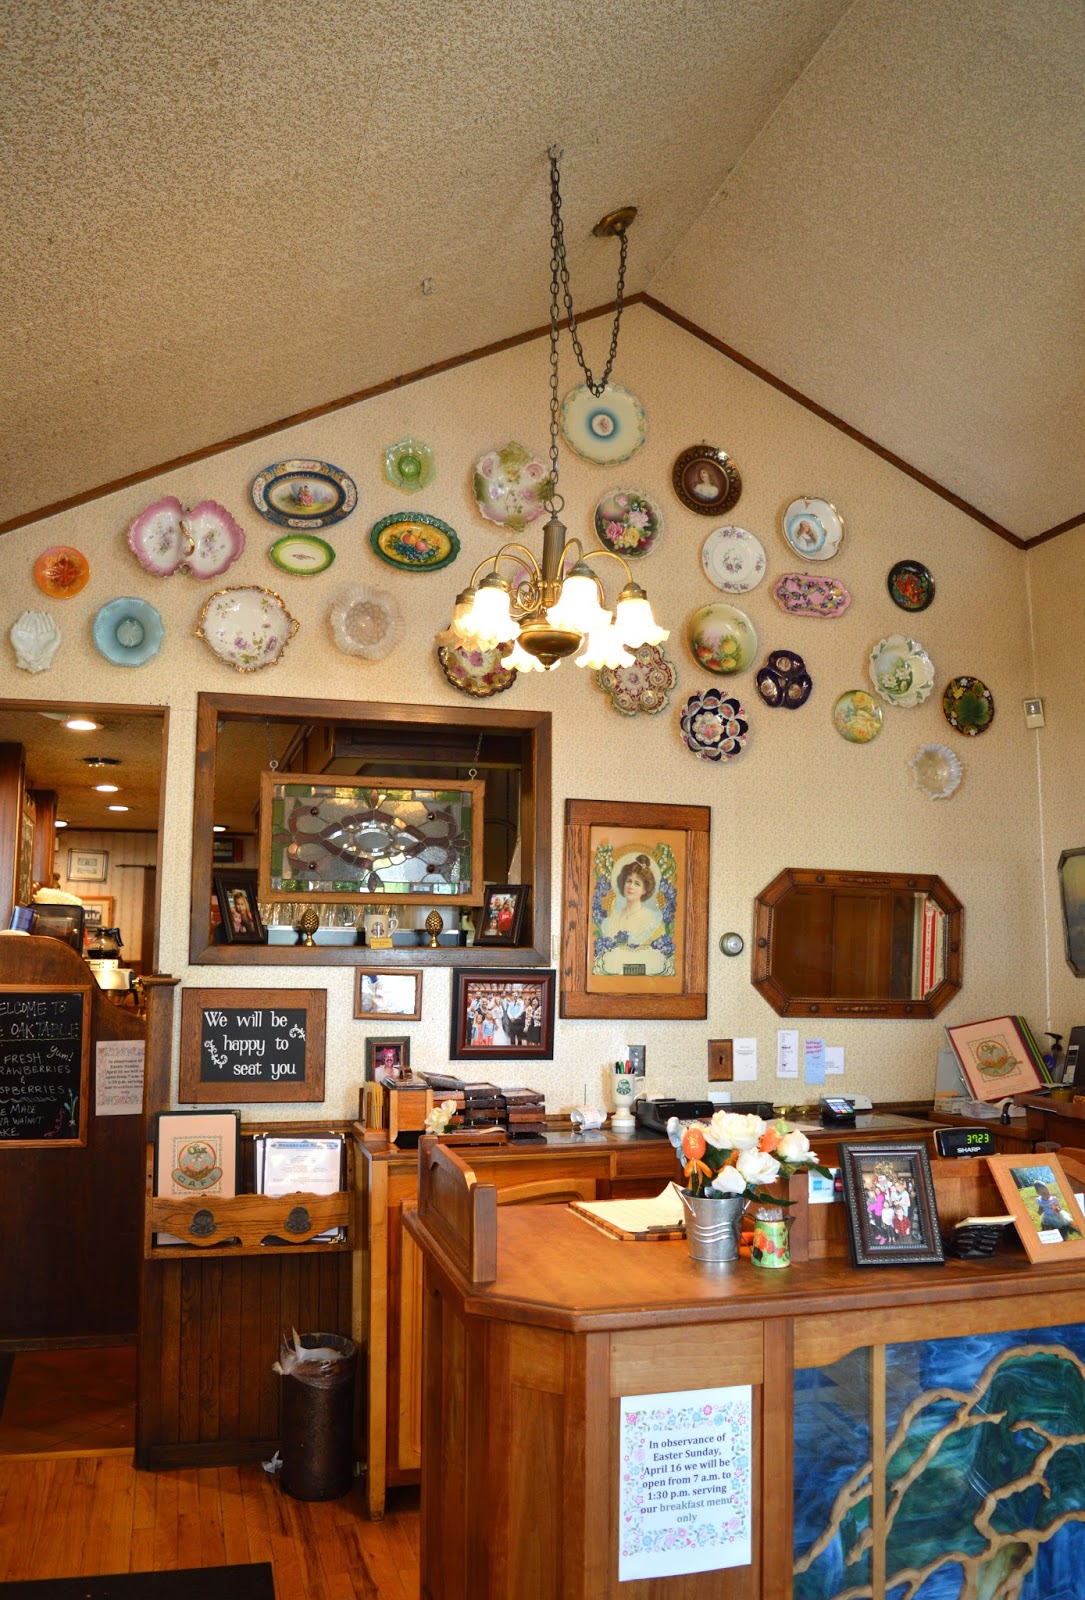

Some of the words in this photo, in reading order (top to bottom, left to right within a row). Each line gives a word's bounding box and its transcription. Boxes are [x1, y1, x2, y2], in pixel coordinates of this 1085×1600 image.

[51, 1001, 66, 1014] TO
[204, 1011, 227, 1027] We
[237, 1011, 262, 1027] will
[270, 1011, 288, 1027] be
[11, 1022, 34, 1038] OAK
[223, 1035, 265, 1056] happy
[275, 1038, 288, 1050] to
[4, 1052, 41, 1064] FRESH
[234, 1063, 262, 1075] seat
[270, 1063, 296, 1080] you
[20, 1076, 25, 1084] &
[10, 1104, 37, 1114] MADE
[649, 1440, 659, 1449] In
[661, 1436, 715, 1448] observance
[716, 1433, 726, 1443] of
[653, 1452, 683, 1462] Easter
[685, 1448, 722, 1459] Sunday,
[643, 1466, 668, 1477] April
[671, 1464, 682, 1472] 16
[684, 1463, 698, 1471] we
[700, 1460, 717, 1469] will
[719, 1459, 730, 1467] be
[642, 1480, 666, 1490] open
[668, 1476, 692, 1486] from
[694, 1475, 699, 1483] 7
[700, 1473, 720, 1482] a.m.
[647, 1491, 668, 1501] 1:30
[670, 1490, 691, 1500] p.m.
[693, 1485, 727, 1496] serving
[640, 1506, 658, 1514] our
[660, 1500, 705, 1512] breakfast
[707, 1497, 733, 1506] menu
[677, 1514, 698, 1524] only
